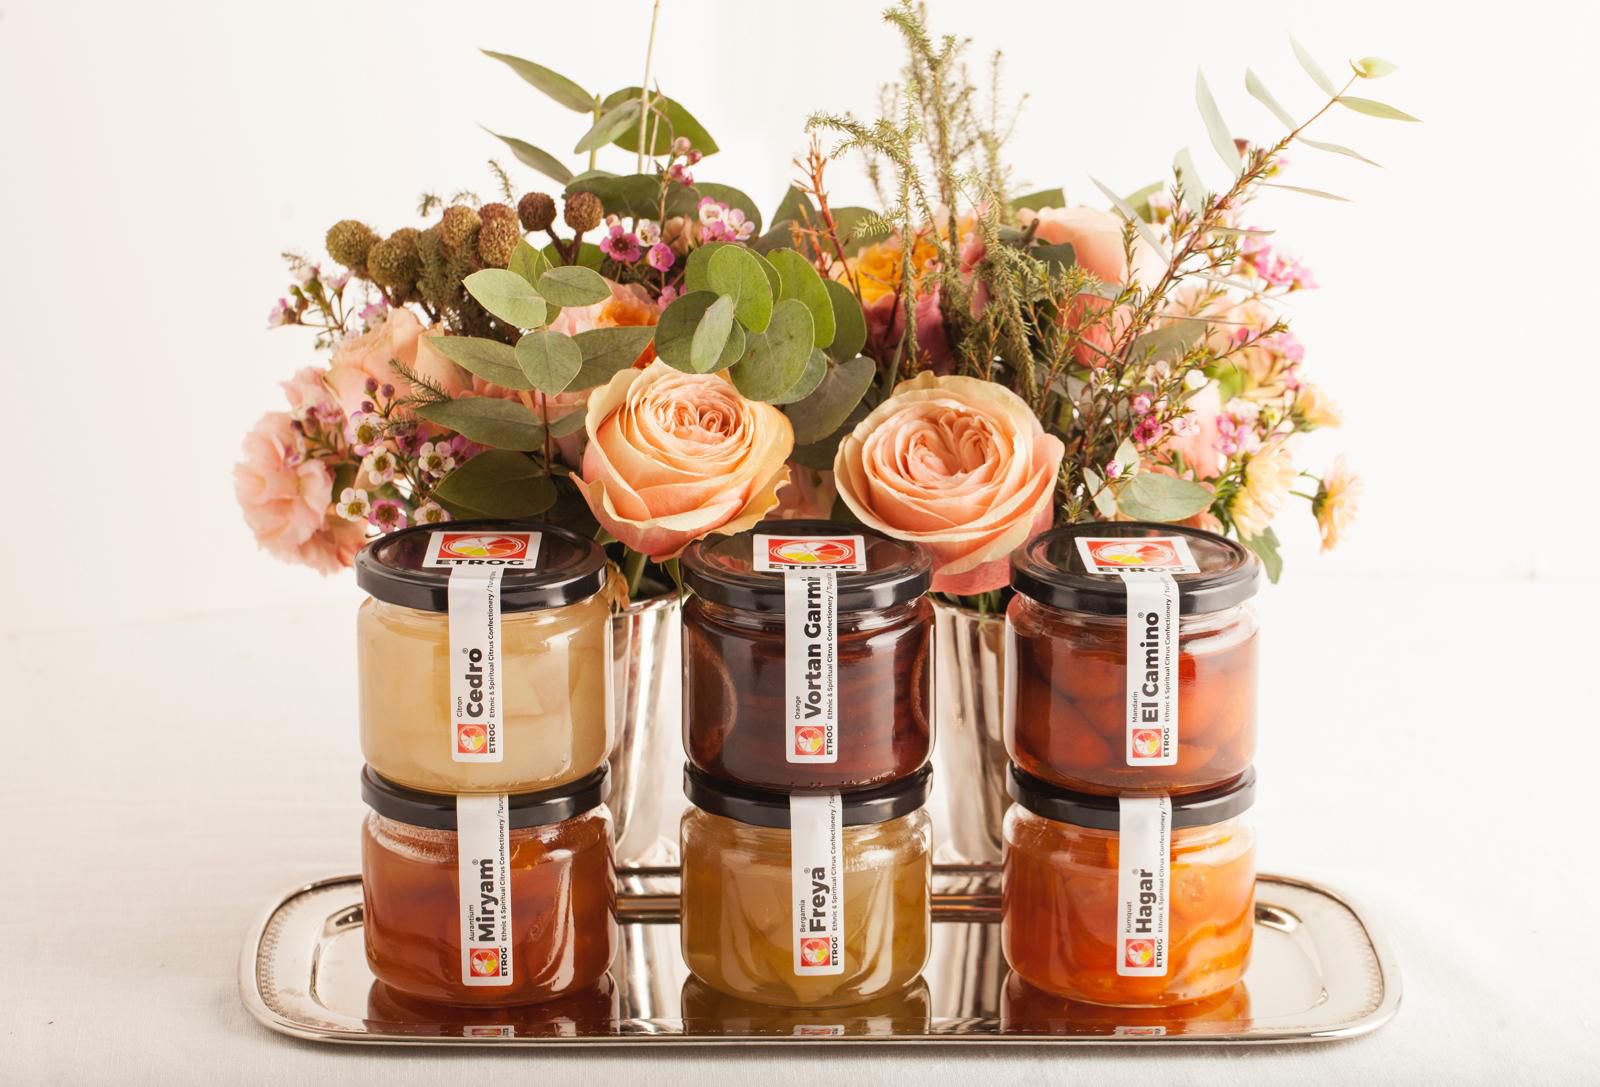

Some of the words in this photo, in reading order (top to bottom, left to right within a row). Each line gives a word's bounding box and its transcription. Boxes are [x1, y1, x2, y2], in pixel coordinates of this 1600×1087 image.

[465, 648, 484, 718] Cedro
[804, 644, 822, 719] Vortan
[1140, 612, 1159, 697] Camino
[1141, 702, 1159, 722] El
[476, 859, 498, 941] Miryam
[809, 867, 829, 932] Freya
[1136, 869, 1156, 933] Hagar
